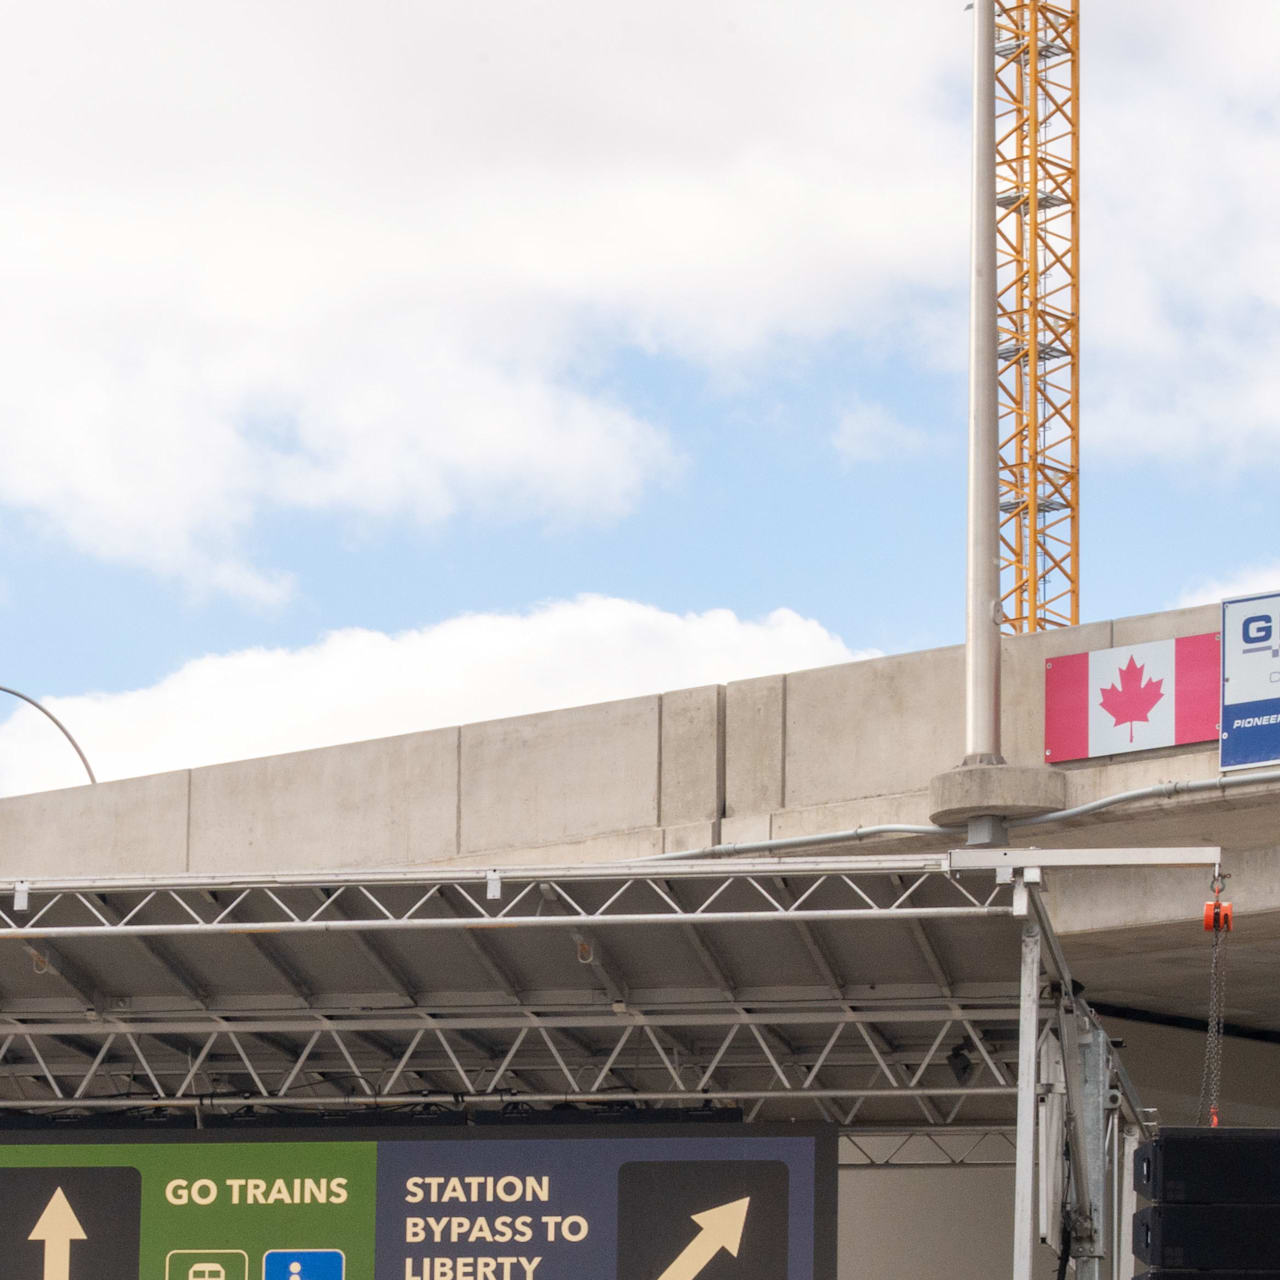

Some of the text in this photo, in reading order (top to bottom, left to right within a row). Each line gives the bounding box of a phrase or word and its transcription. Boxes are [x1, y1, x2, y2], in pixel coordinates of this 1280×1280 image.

[165, 1178, 348, 1206] GO TRAINS
[405, 1176, 549, 1203] STATION
[405, 1216, 589, 1243] BYPASS TO
